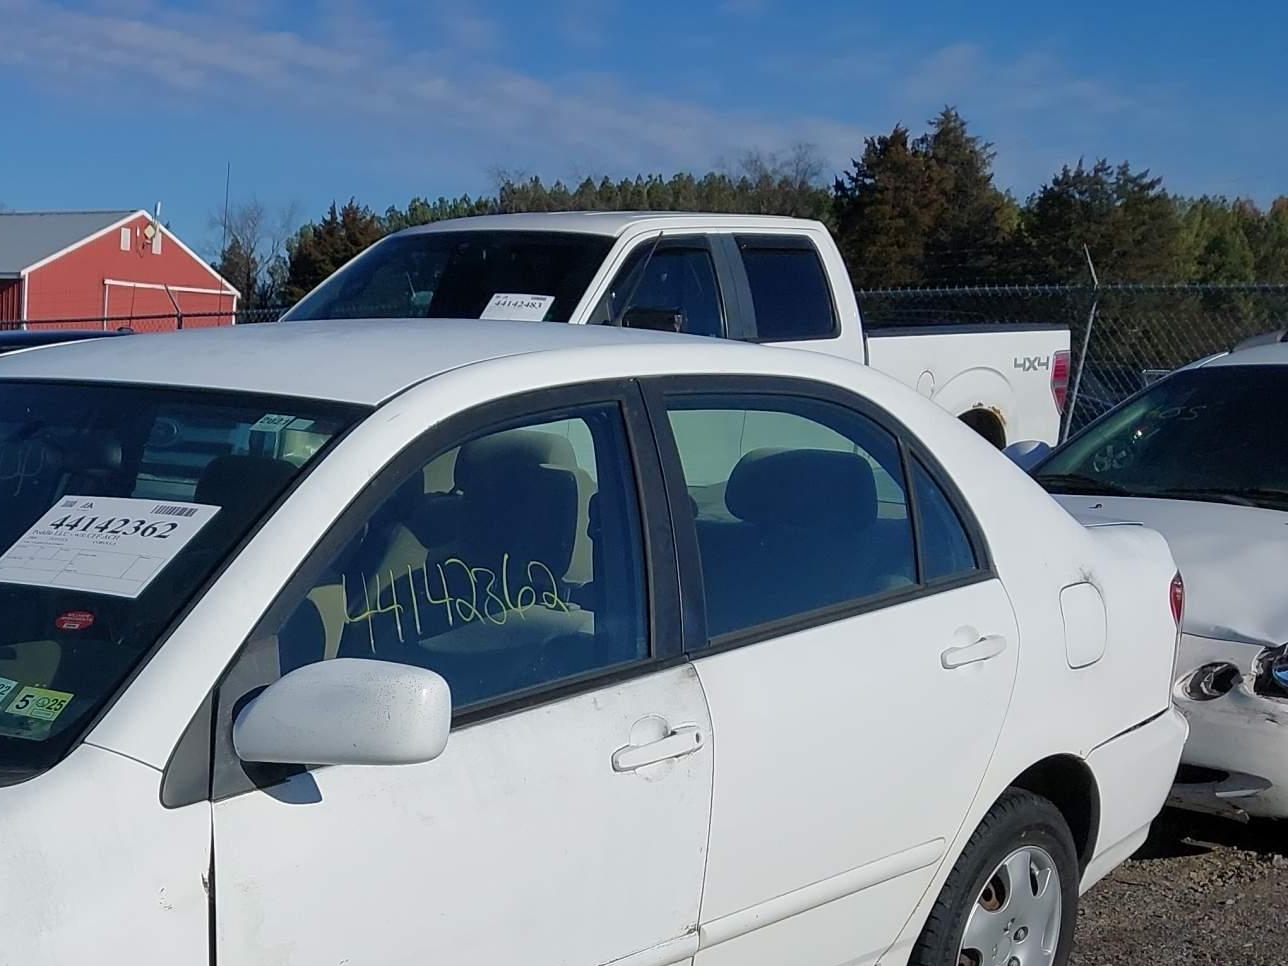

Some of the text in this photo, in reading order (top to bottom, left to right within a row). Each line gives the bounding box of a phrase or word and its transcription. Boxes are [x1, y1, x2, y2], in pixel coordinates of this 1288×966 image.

[49, 515, 179, 539] 44142362
[342, 553, 571, 654] 44142362
[15, 695, 66, 711] 5 25
